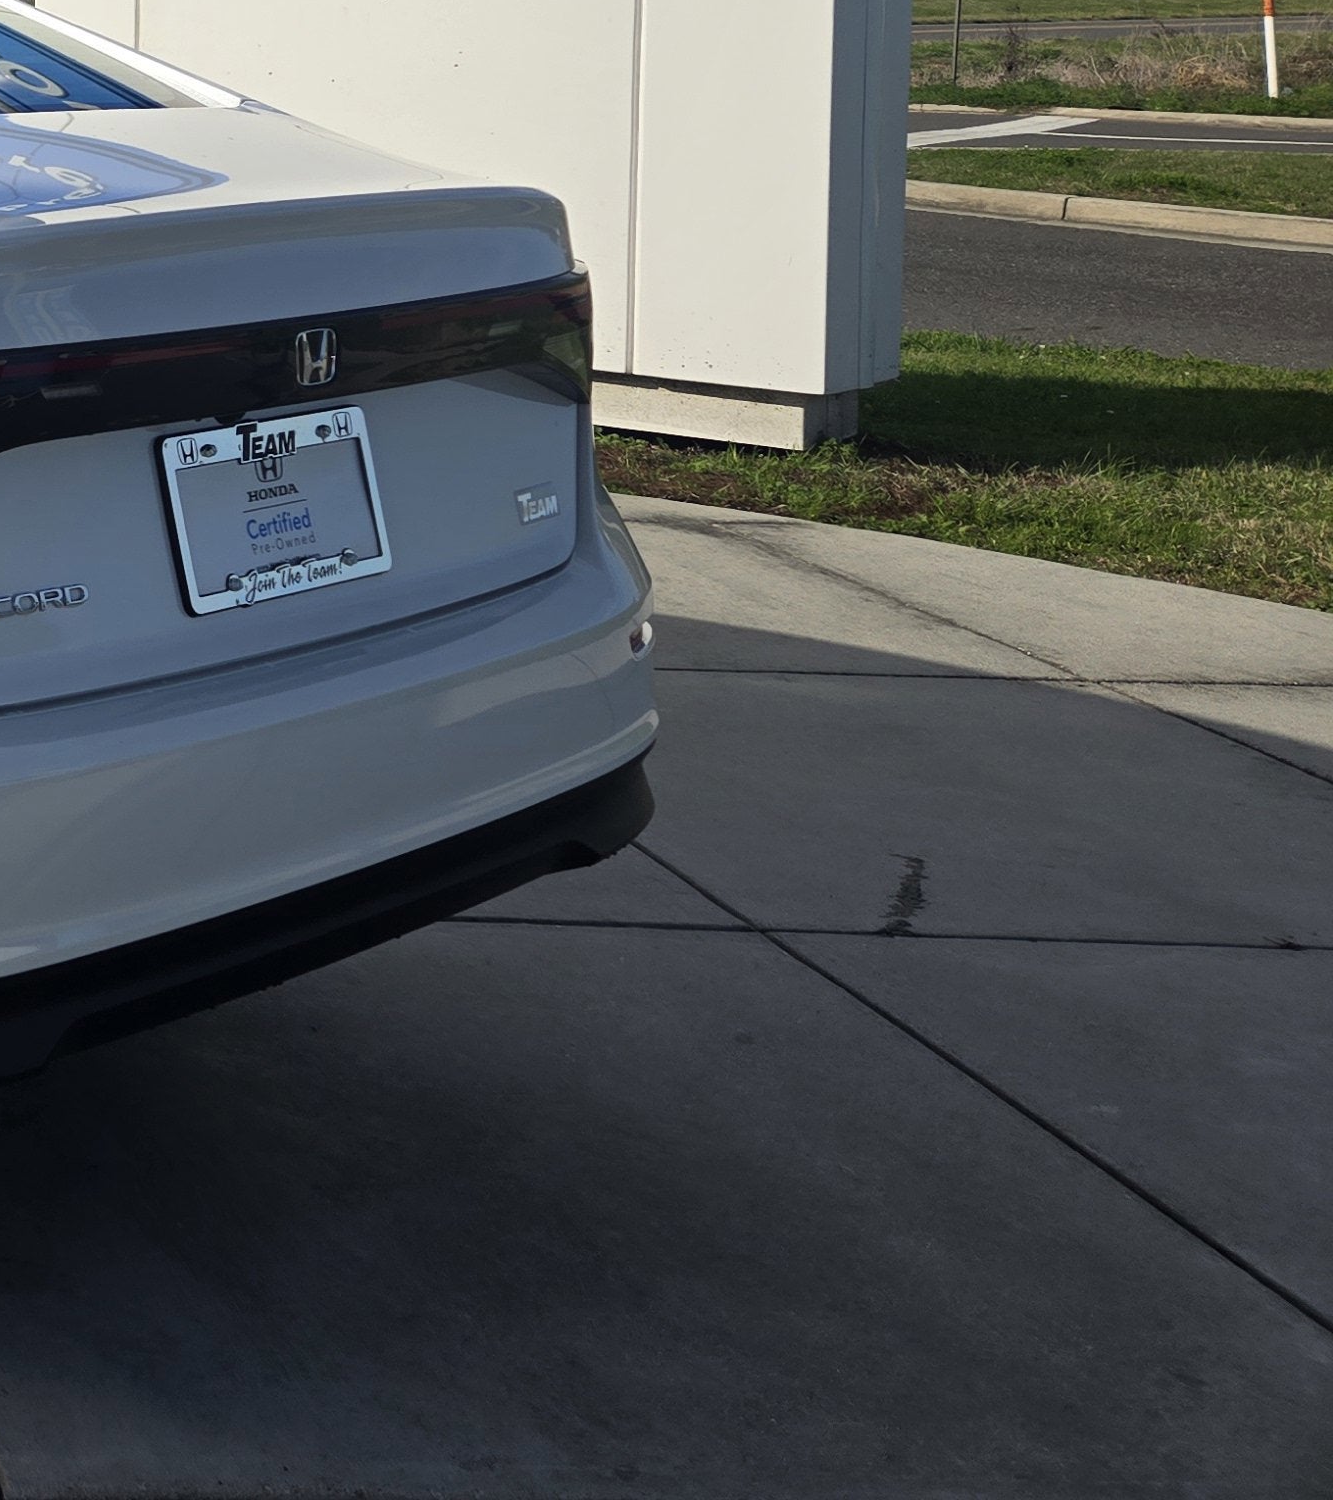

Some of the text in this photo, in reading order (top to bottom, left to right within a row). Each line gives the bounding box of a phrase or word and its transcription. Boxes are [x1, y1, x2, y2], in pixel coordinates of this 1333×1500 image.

[236, 423, 296, 461] TEAM
[247, 483, 299, 502] HONDA
[517, 492, 558, 522] TEAM
[246, 507, 312, 539] Certified
[251, 531, 317, 555] Pre-Owned
[246, 558, 343, 603] Join The Team!
